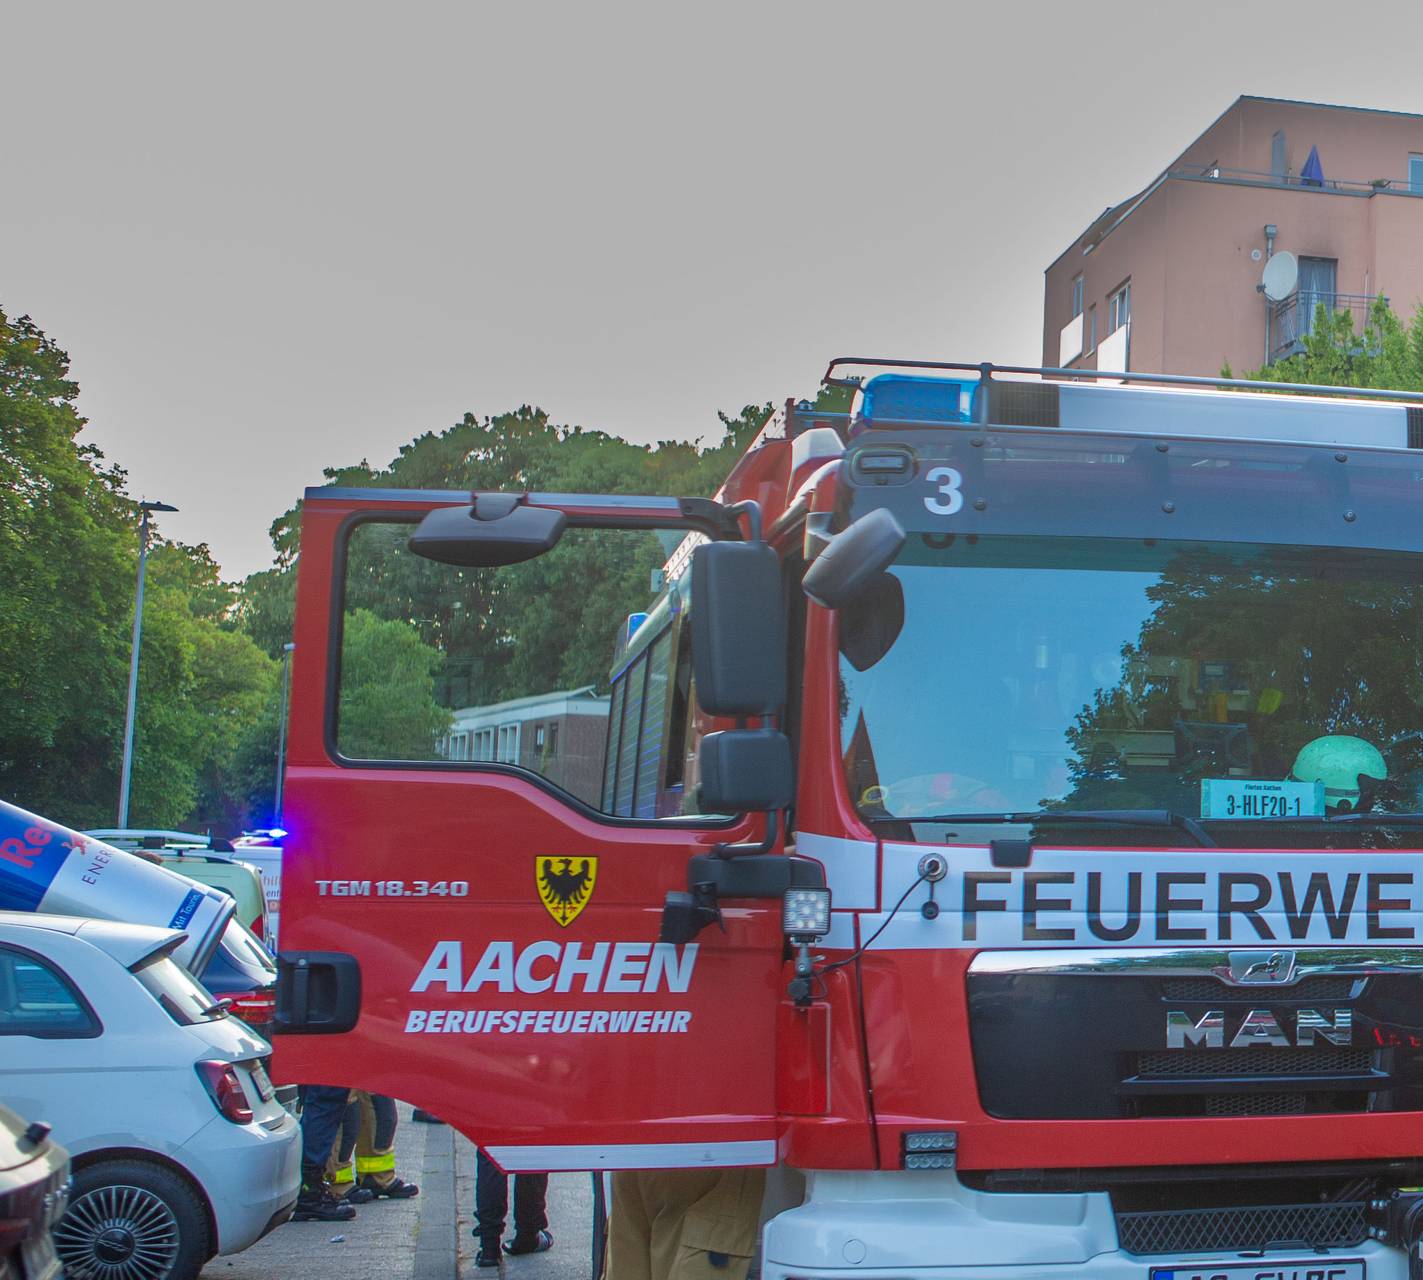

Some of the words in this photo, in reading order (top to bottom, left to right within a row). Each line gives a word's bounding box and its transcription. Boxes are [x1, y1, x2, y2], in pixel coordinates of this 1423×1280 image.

[923, 466, 964, 516] 3
[1227, 794, 1301, 817] 3-HLF20-1
[315, 880, 371, 896] TGM
[375, 880, 469, 897] 18.340
[409, 941, 700, 994] AACHEN
[404, 1010, 692, 1034] BERUFSFEUERWEHR
[1166, 1009, 1353, 1049] MAN
